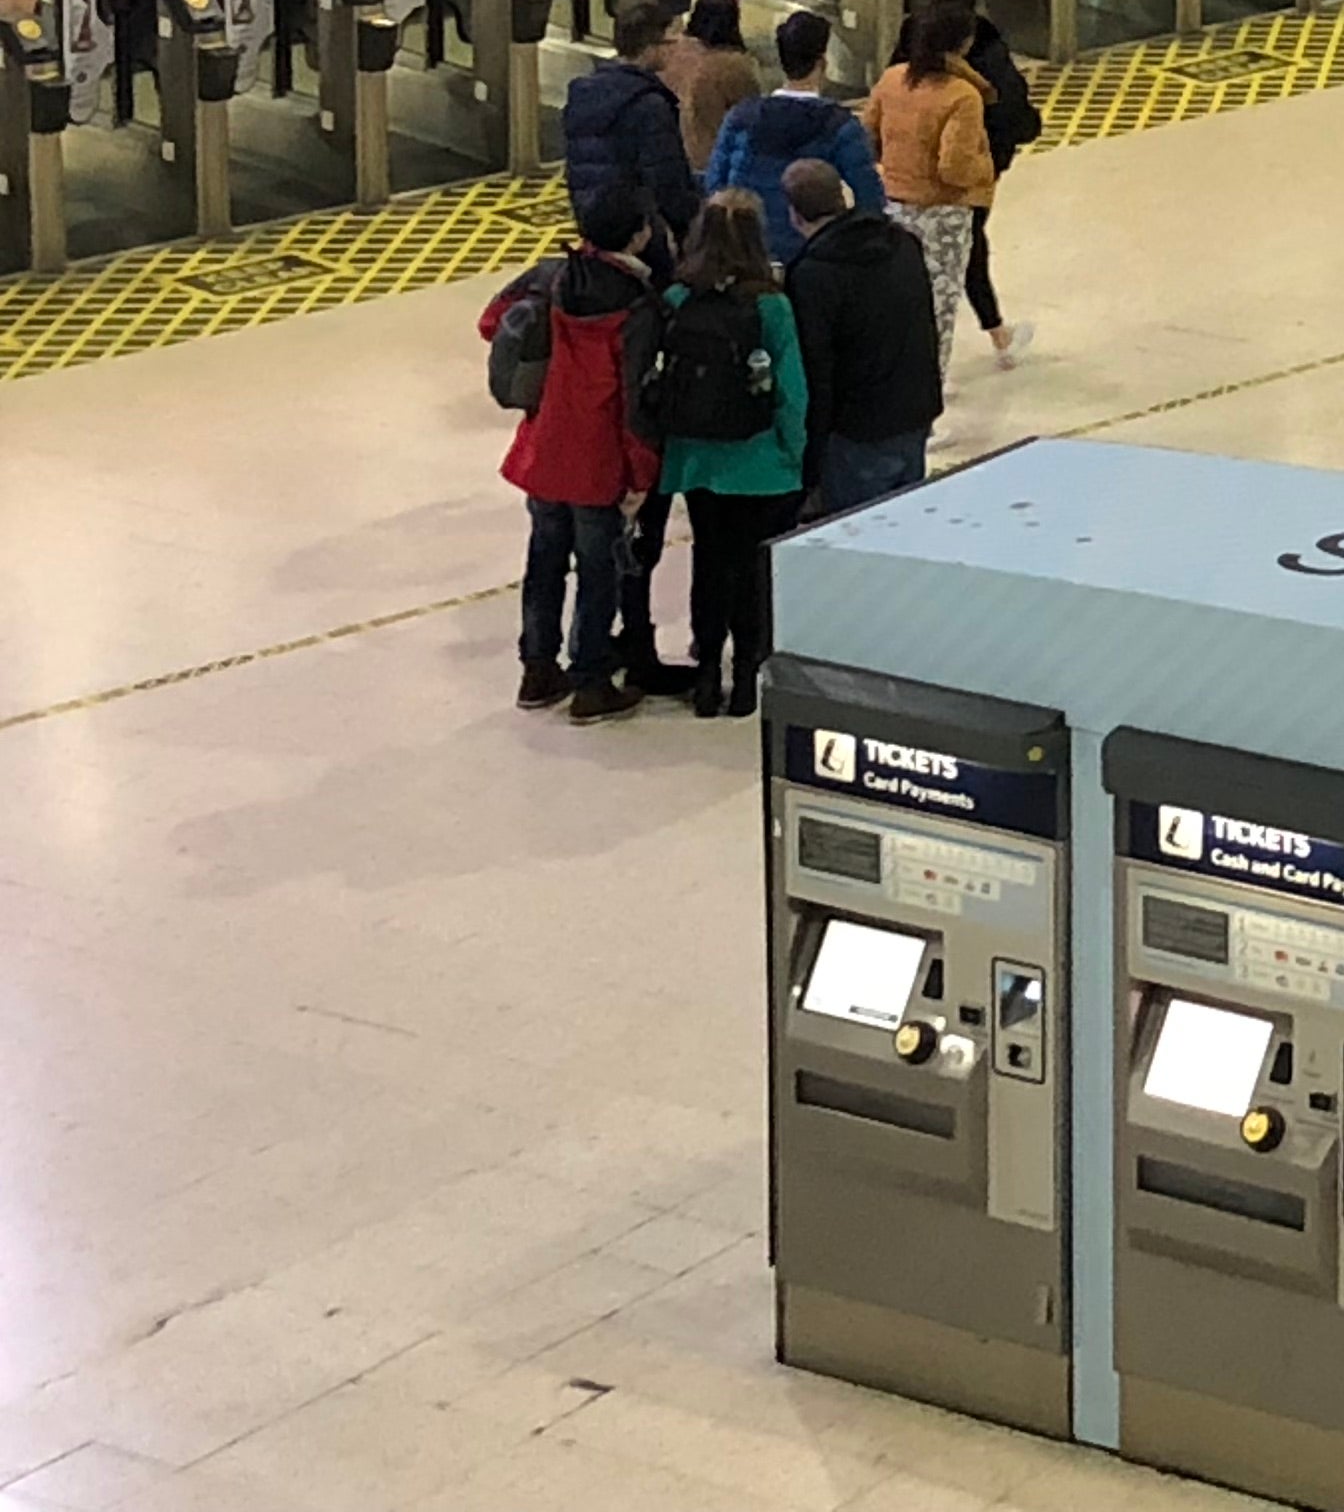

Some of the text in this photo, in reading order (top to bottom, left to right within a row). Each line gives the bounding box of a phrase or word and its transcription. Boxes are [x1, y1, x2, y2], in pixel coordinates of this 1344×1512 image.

[863, 739, 958, 779] TICKETS
[864, 771, 974, 809] Card Payments
[1211, 817, 1310, 858] TICKETS
[1211, 848, 1249, 870] Cash
[1251, 861, 1280, 878] and
[1283, 864, 1320, 887] Card
